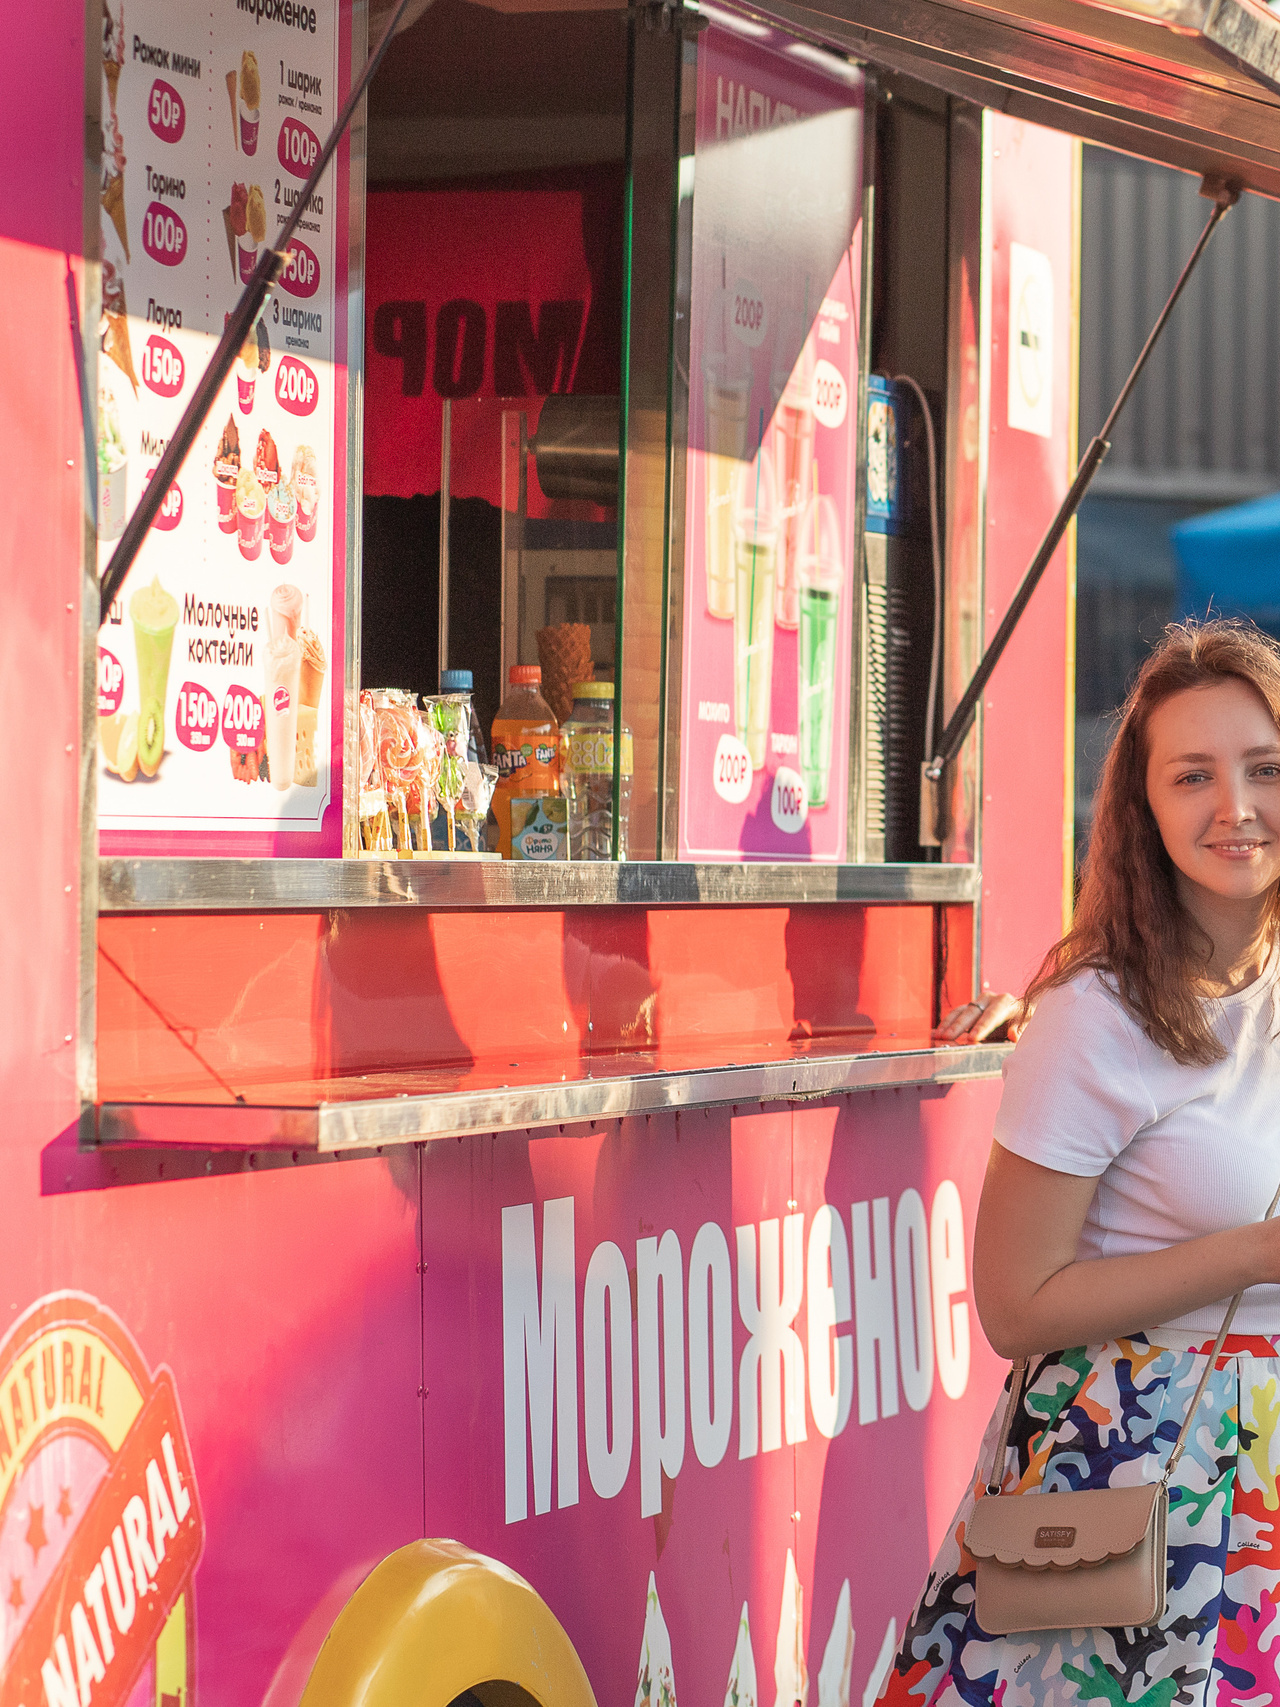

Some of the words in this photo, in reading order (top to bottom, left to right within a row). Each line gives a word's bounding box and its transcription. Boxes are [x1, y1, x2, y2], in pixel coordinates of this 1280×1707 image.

[133, 34, 170, 71] Рожок
[171, 59, 201, 80] мини
[279, 60, 285, 86] 1
[287, 67, 322, 99] шарик
[145, 165, 186, 201] Торино
[274, 178, 281, 205] 2
[146, 298, 182, 334] Лаура
[273, 299, 279, 324] 3
[282, 306, 322, 335] шарика
[183, 592, 259, 632] Молочные
[188, 630, 253, 667] коктейли
[501, 1179, 971, 1525] Мороженое
[1237, 1541, 1260, 1549] Collect
[933, 1571, 950, 1592] Collect
[1013, 1653, 1032, 1674] Collect
